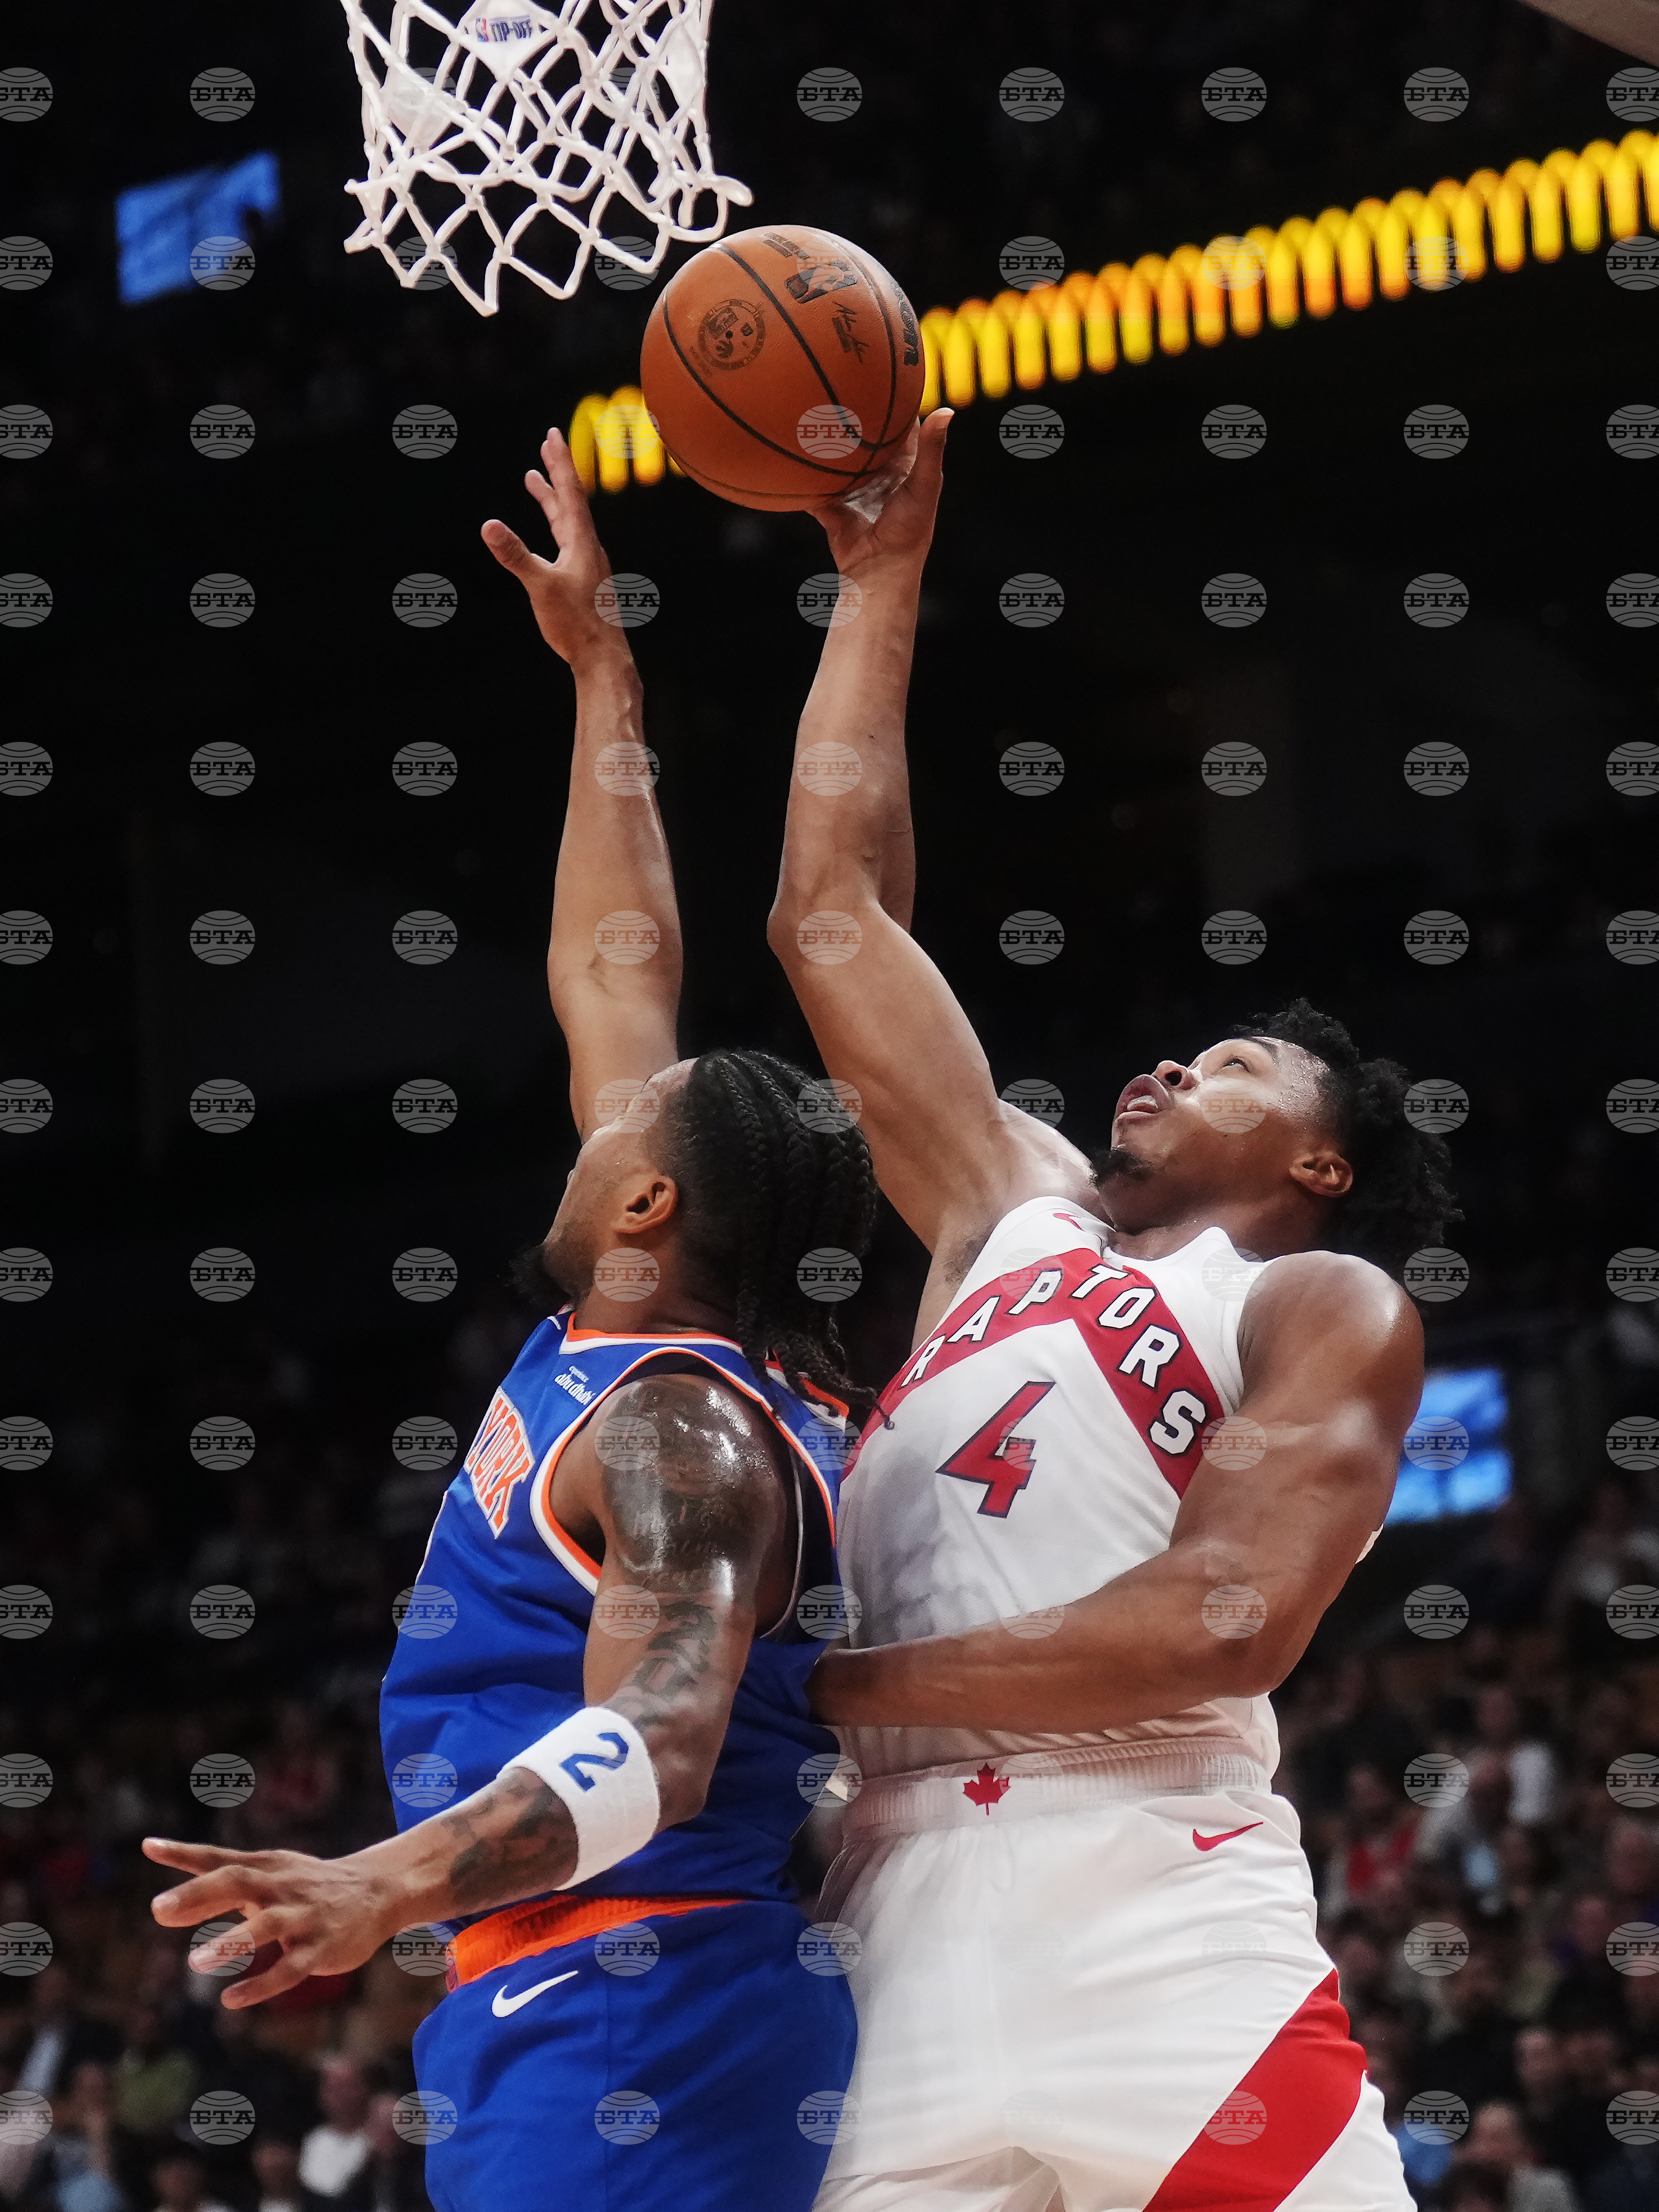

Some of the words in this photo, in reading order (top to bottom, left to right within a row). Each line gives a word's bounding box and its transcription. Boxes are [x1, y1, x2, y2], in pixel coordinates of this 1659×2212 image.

[899, 1264, 1207, 1455] RAPTORS
[464, 1385, 535, 1539] YORK
[935, 1381, 1055, 1518] 4
[560, 1731, 629, 1792] 2
